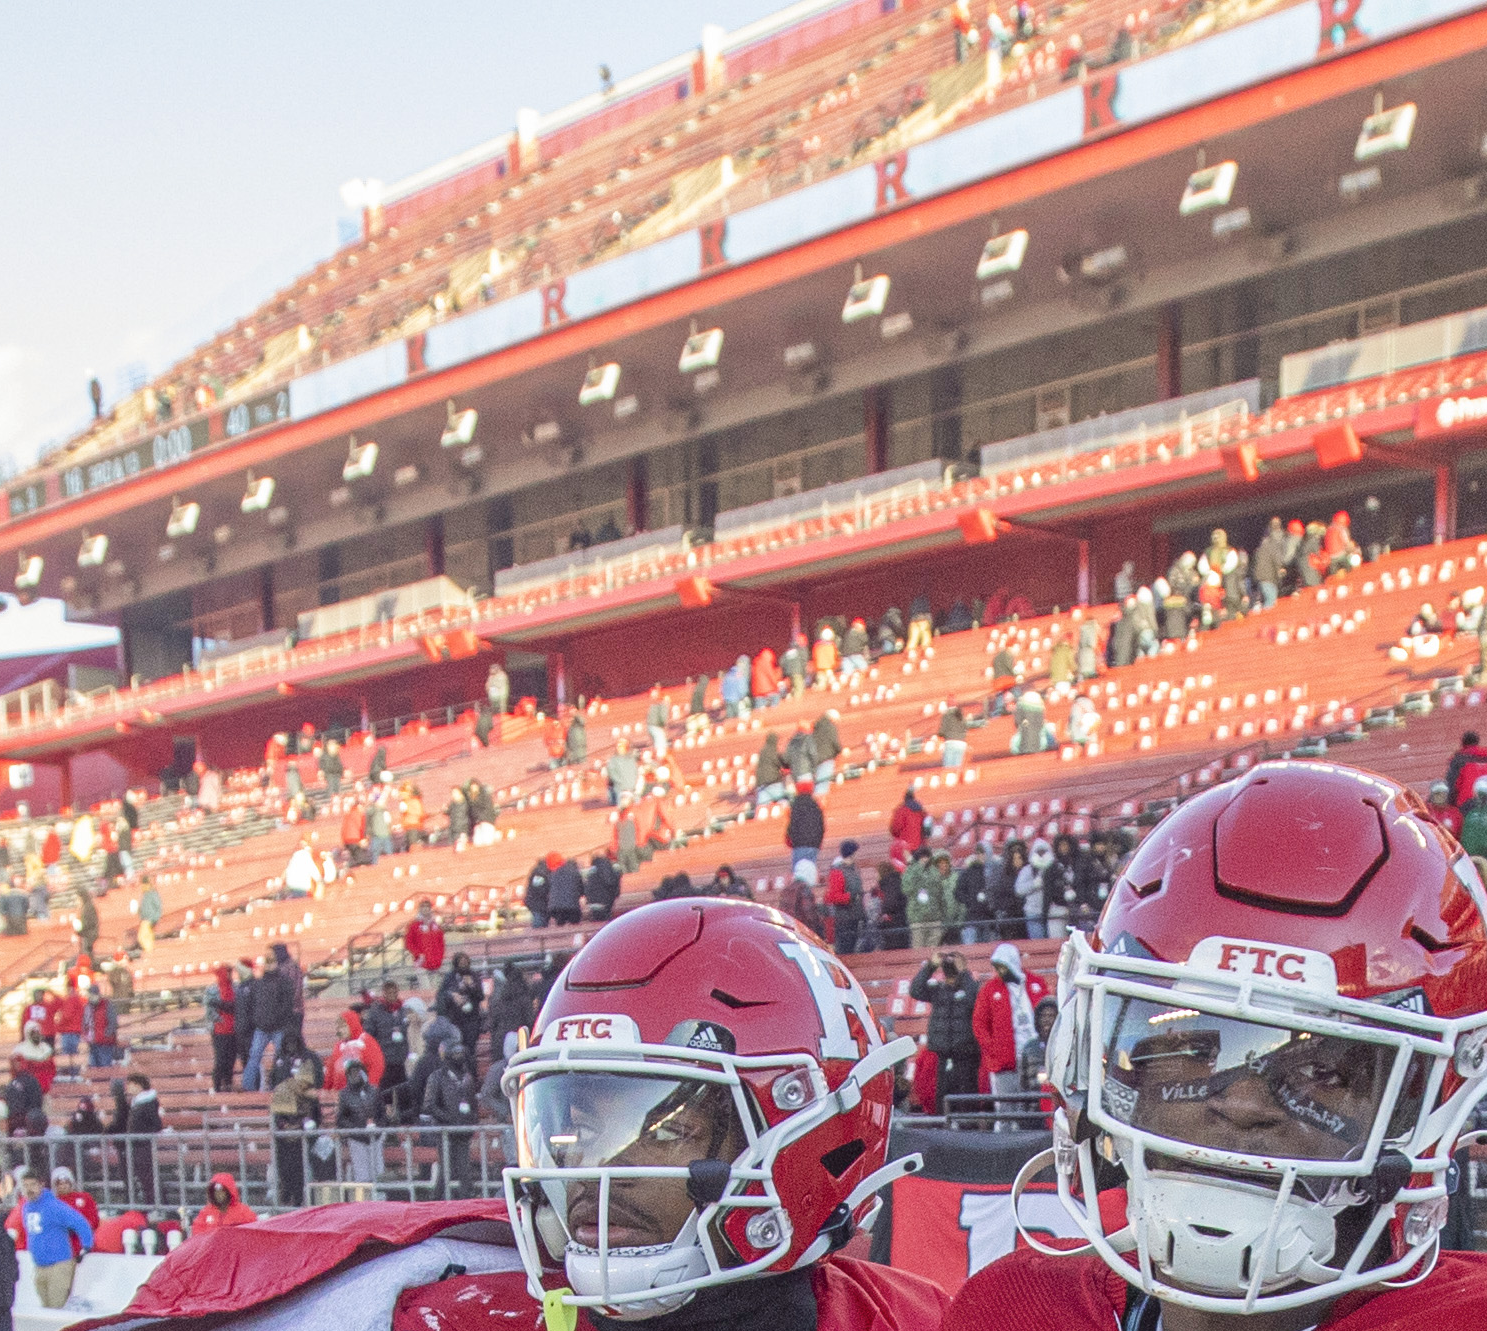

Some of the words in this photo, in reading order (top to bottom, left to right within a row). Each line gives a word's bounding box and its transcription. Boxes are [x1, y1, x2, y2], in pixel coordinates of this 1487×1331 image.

[875, 148, 909, 213] R
[542, 277, 573, 328] R
[1218, 943, 1307, 983] F.T.C.
[690, 1039, 722, 1051] adidas
[27, 1212, 45, 1233] R
